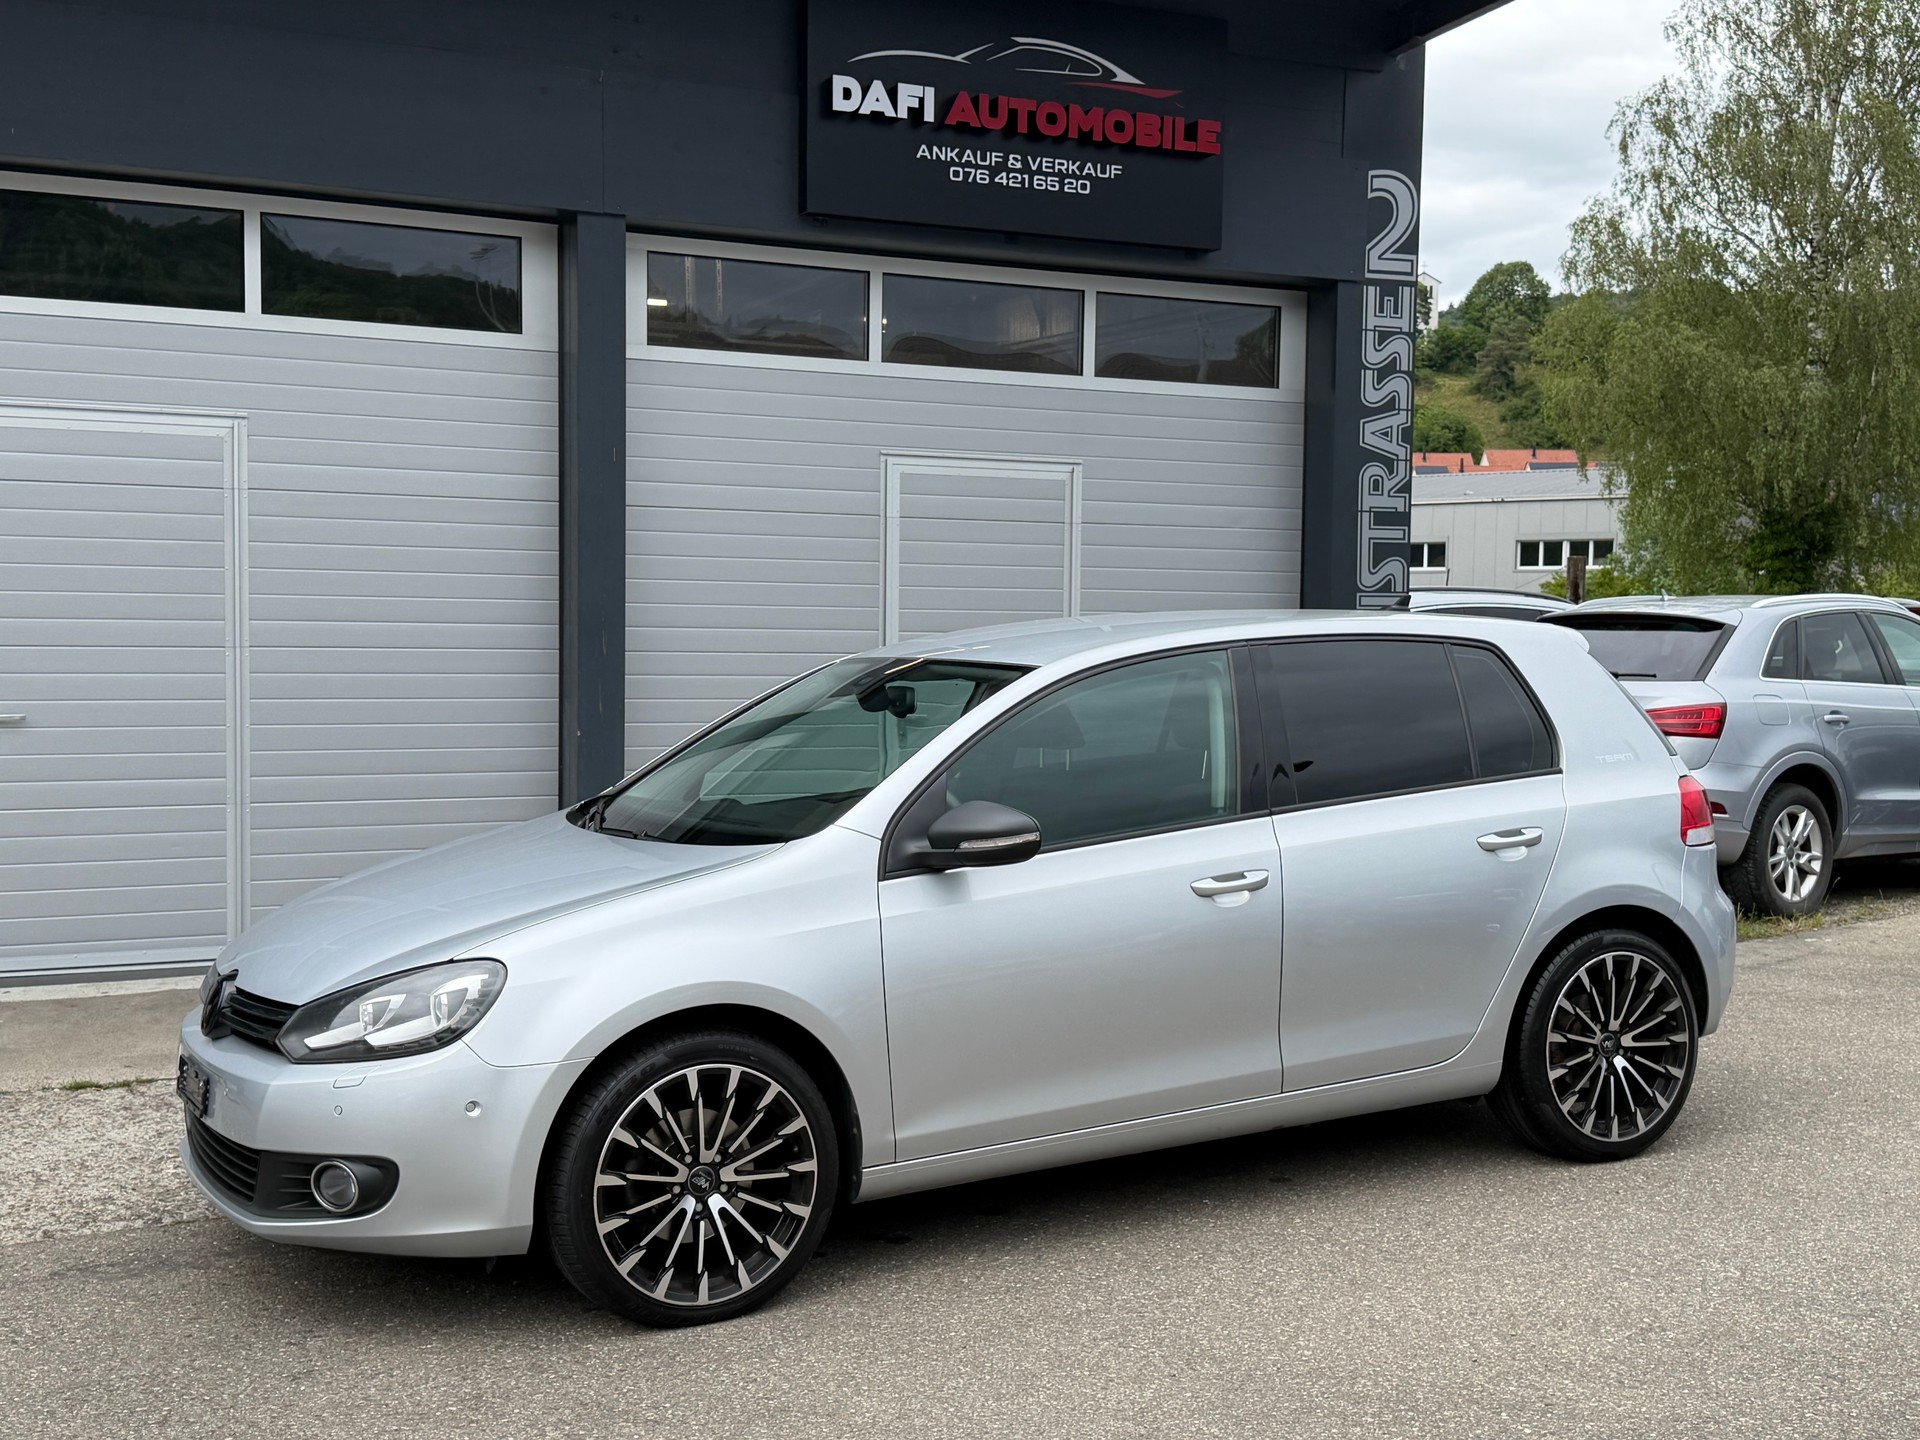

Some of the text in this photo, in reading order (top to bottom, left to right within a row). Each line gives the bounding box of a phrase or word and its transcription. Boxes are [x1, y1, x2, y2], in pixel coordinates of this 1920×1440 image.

[832, 74, 1222, 155] DAFI AUTOMOBILE
[916, 144, 1123, 179] ANKAUF & VERKAUF
[949, 166, 1091, 195] 076 421 65 20
[1364, 169, 1418, 281] 2
[1594, 752, 1634, 764] TEAM
